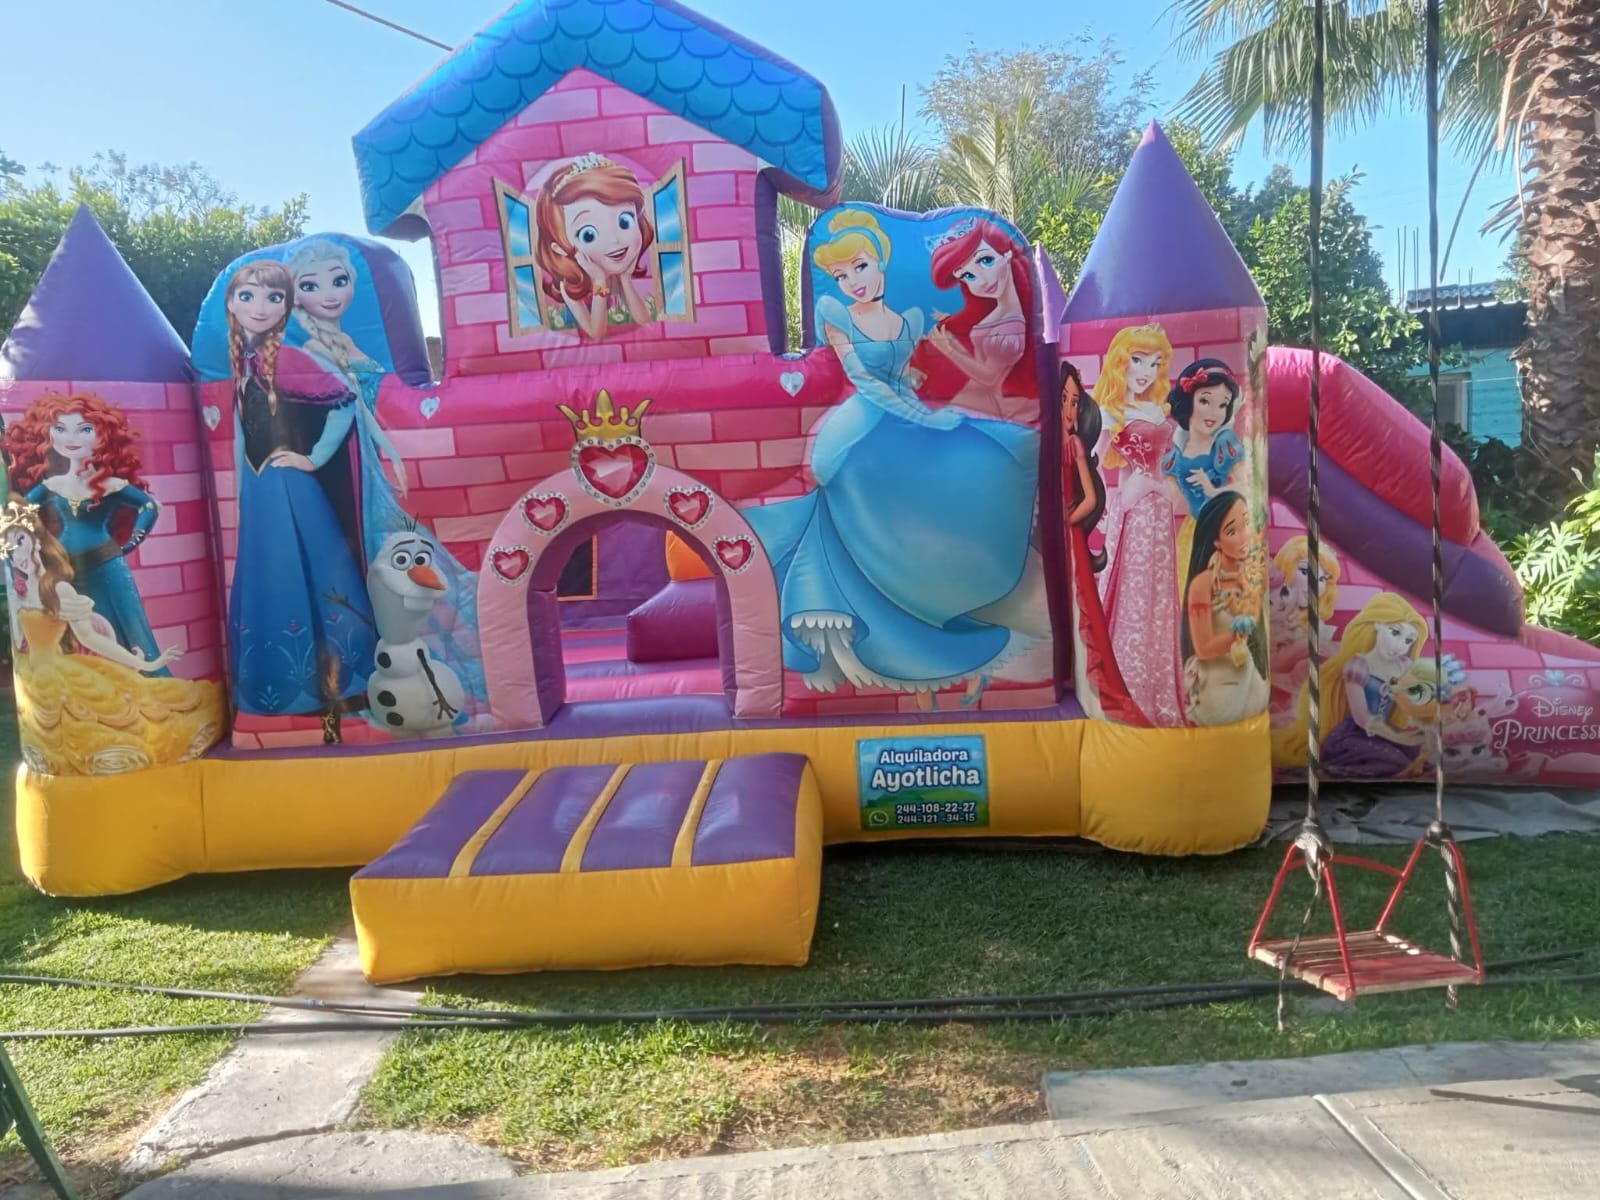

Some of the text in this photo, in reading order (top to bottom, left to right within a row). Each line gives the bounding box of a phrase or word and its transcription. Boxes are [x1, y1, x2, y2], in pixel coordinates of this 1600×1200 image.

[1492, 718, 1600, 749] PRINCESS
[880, 750, 968, 765] Alquiladora
[872, 765, 980, 791] Ayotlicha
